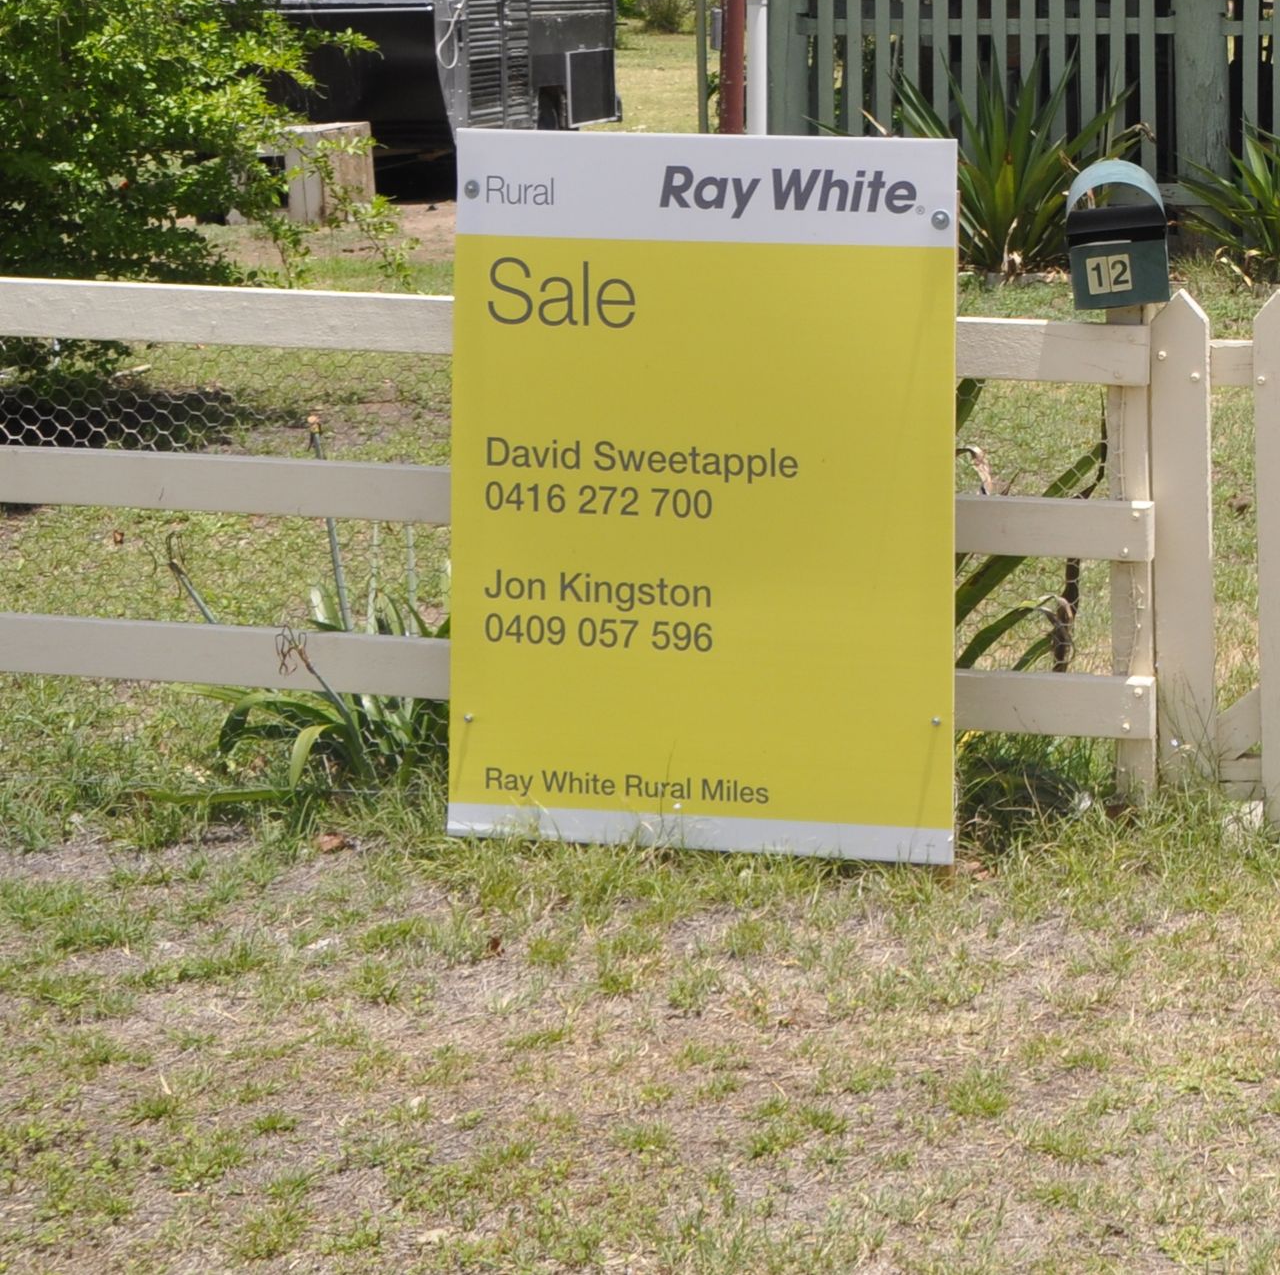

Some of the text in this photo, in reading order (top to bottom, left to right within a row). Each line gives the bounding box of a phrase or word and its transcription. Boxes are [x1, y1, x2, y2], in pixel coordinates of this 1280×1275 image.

[485, 174, 556, 207] Rural
[658, 165, 919, 220] Ray White
[486, 255, 637, 330] Sale
[1090, 259, 1130, 288] 12
[485, 435, 800, 486] David Sweetapple
[484, 479, 714, 521] 0416 272 700
[483, 568, 712, 613] Jon Kingston
[484, 611, 714, 654] 0409 057 596
[484, 766, 770, 806] Ray White Rural Miles
